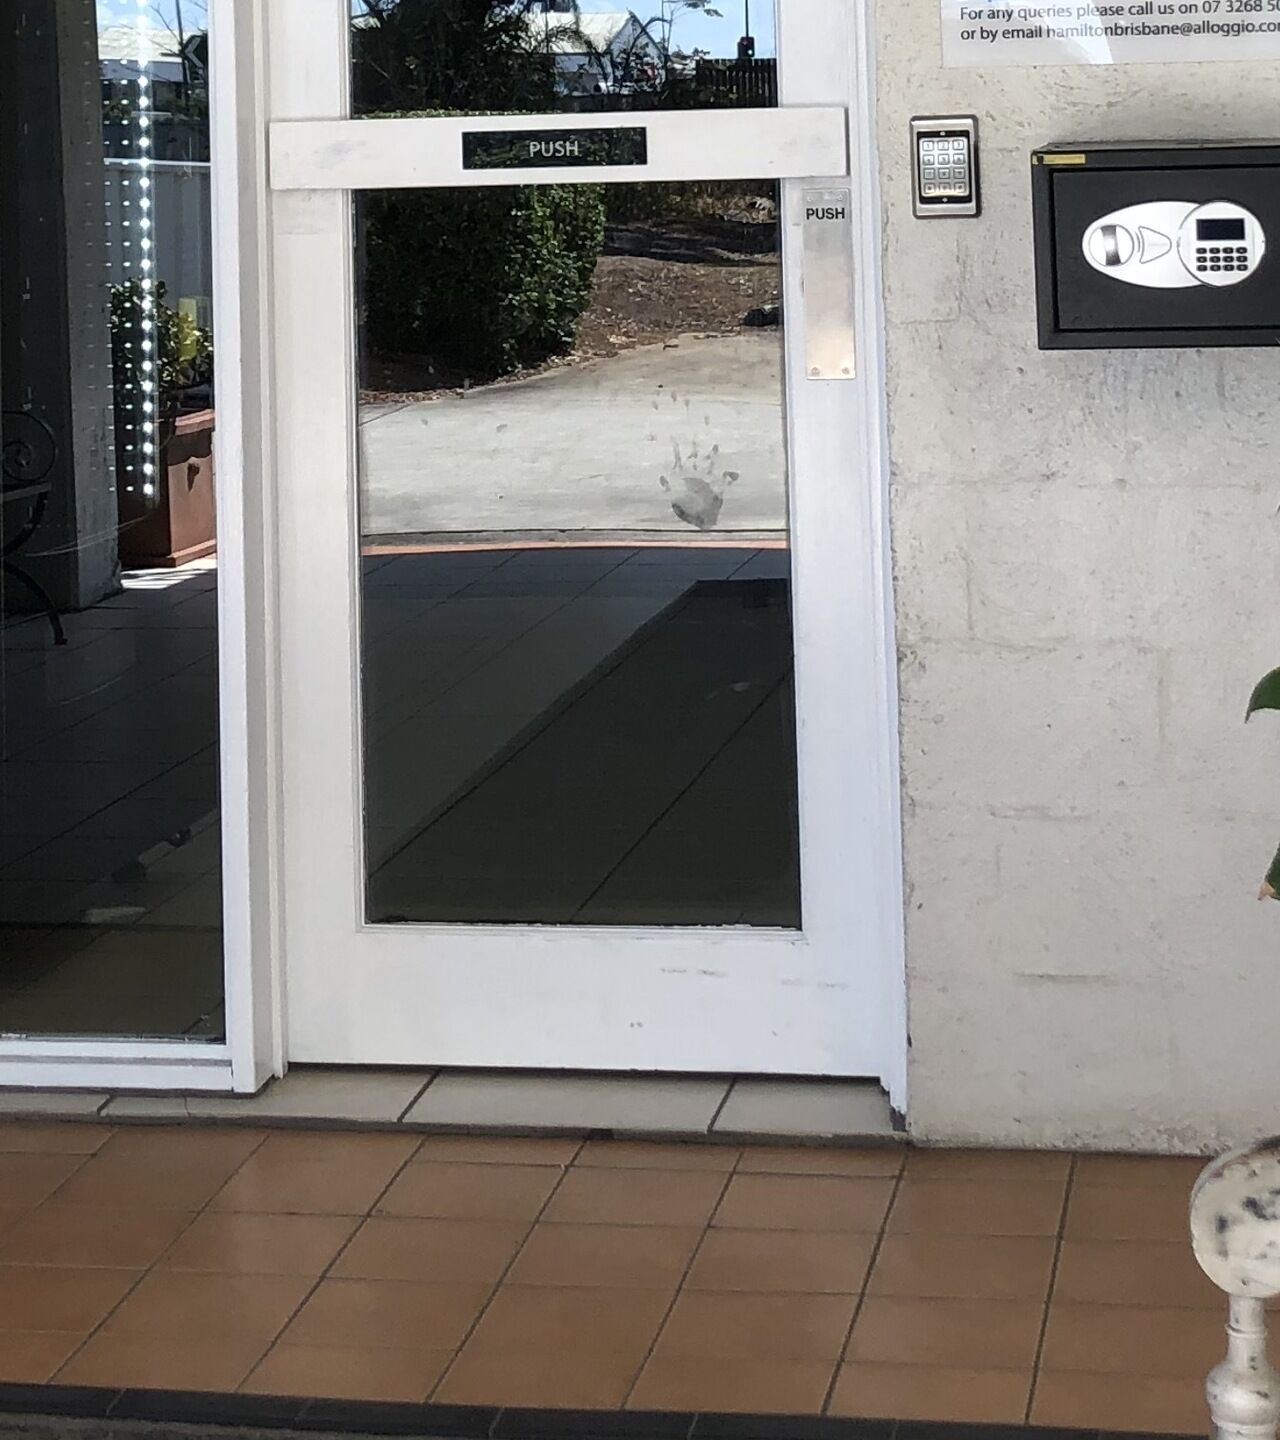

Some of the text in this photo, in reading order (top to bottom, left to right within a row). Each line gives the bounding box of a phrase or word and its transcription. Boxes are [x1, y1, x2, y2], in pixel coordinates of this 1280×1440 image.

[960, 7, 983, 20] For
[987, 7, 1014, 21] any
[1018, 5, 1071, 21] queries
[1077, 3, 1121, 19] please
[1128, 1, 1153, 16] call
[1158, 2, 1175, 14] us
[1178, 2, 1198, 14] on
[1202, 0, 1220, 13] 07
[1226, 0, 1262, 13] 3268
[961, 27, 977, 40] or
[980, 26, 997, 42] by
[1002, 24, 1042, 38] email
[529, 140, 578, 157] PUSH
[806, 207, 845, 220] PUSH
